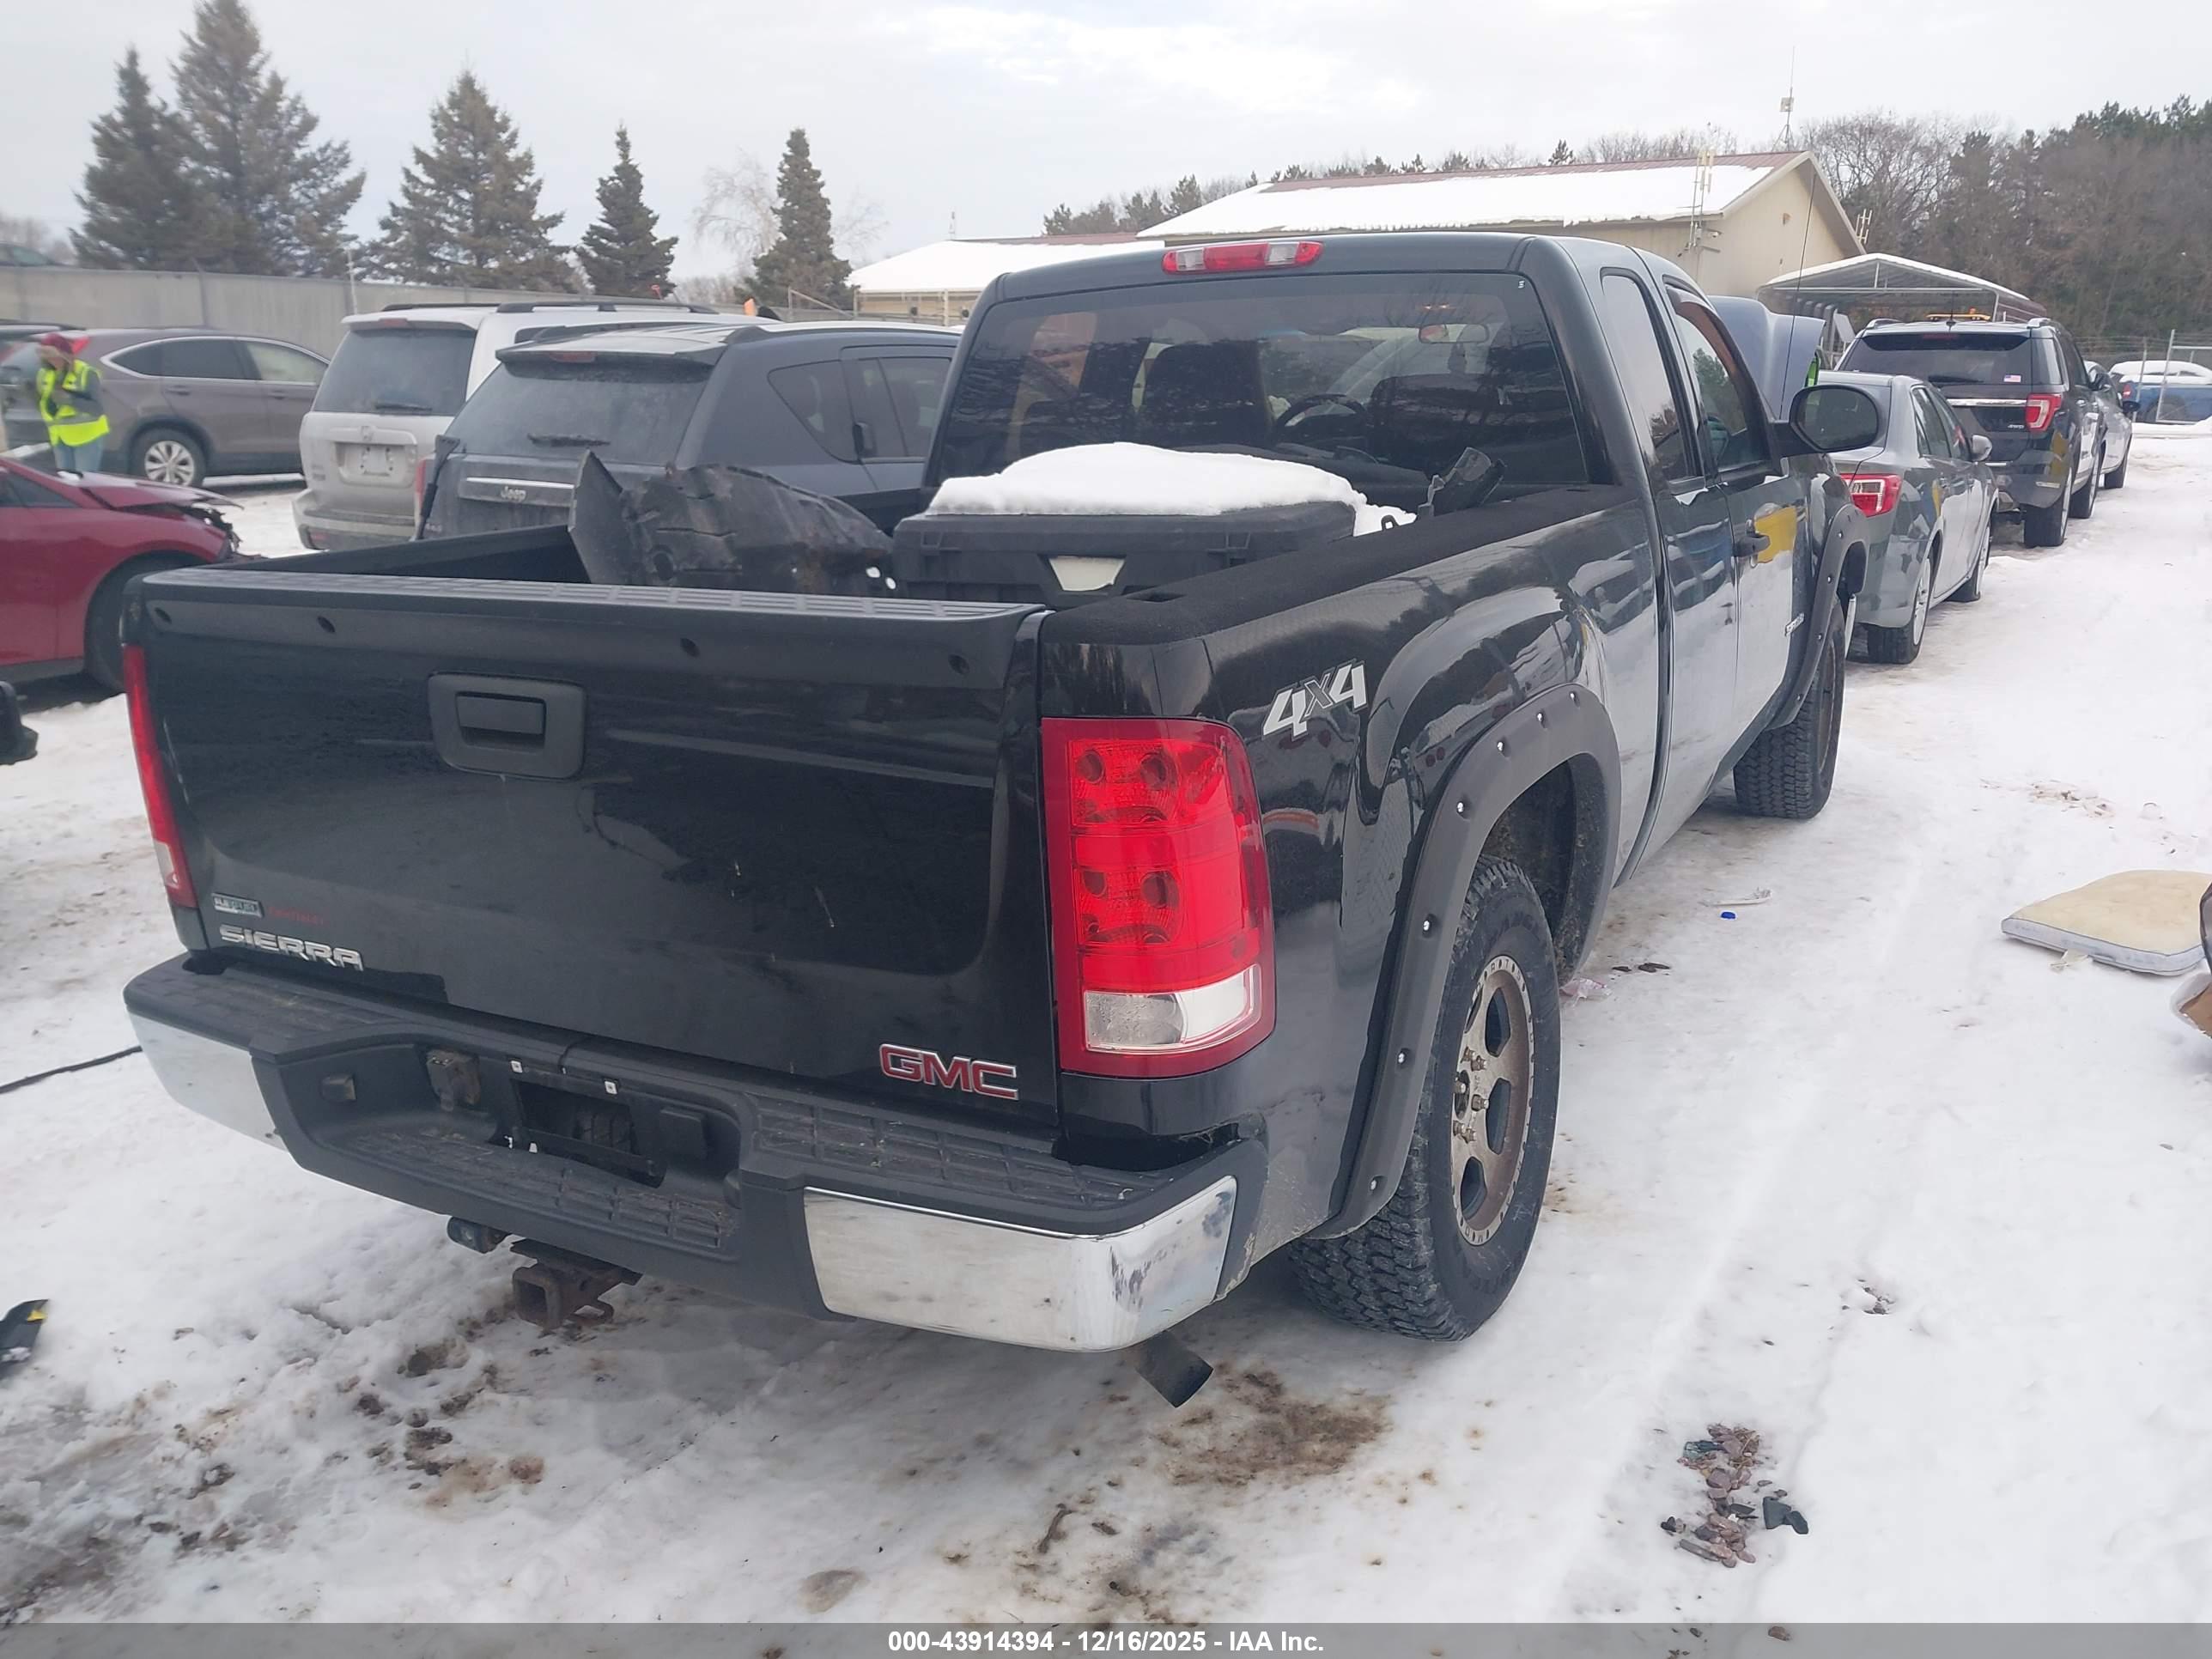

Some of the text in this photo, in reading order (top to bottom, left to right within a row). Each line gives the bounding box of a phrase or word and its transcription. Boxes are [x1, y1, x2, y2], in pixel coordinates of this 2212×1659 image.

[501, 485, 526, 503] Jeep
[219, 924, 364, 972] SIERRA
[879, 1043, 1020, 1101] GMC
